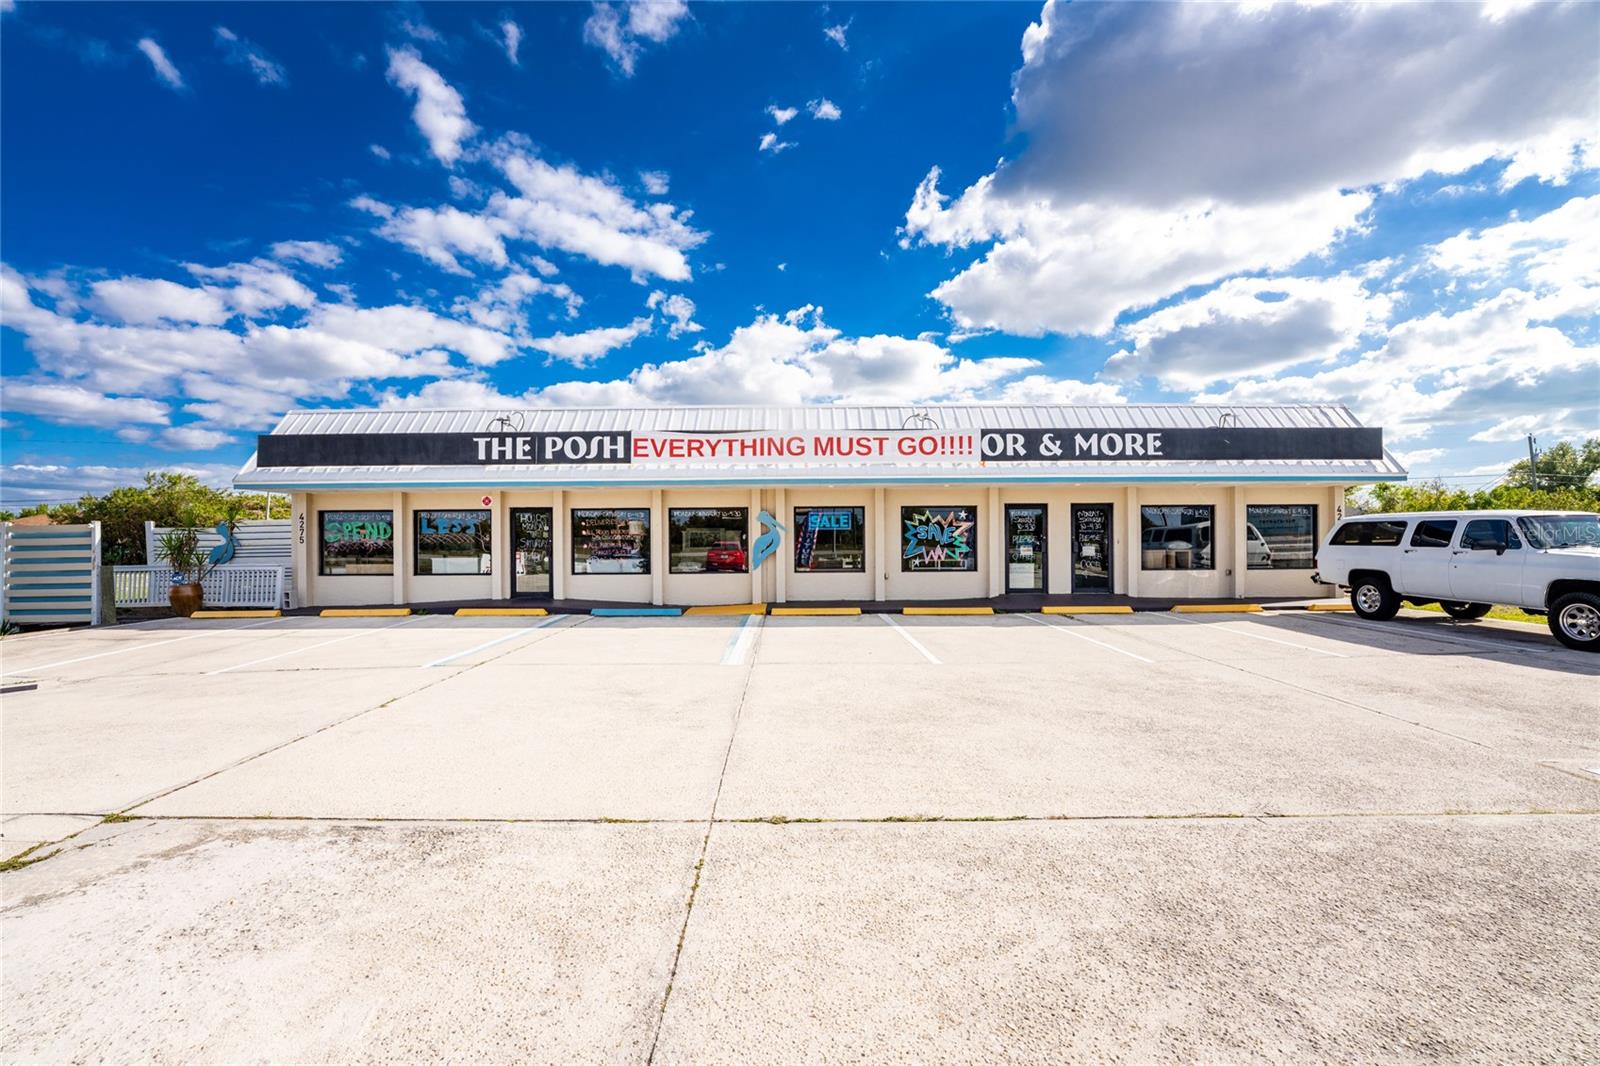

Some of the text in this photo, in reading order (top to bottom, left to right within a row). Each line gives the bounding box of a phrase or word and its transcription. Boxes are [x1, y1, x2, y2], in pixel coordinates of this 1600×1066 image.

[473, 435, 625, 461] THE POSH
[632, 435, 974, 458] EVERYTHING MUST GO!!!!
[1039, 433, 1062, 456] &
[1074, 432, 1163, 456] MORE
[323, 520, 392, 543] SPEND
[421, 516, 476, 535] LESS
[810, 515, 849, 528] SALE
[917, 523, 956, 544] SAVE
